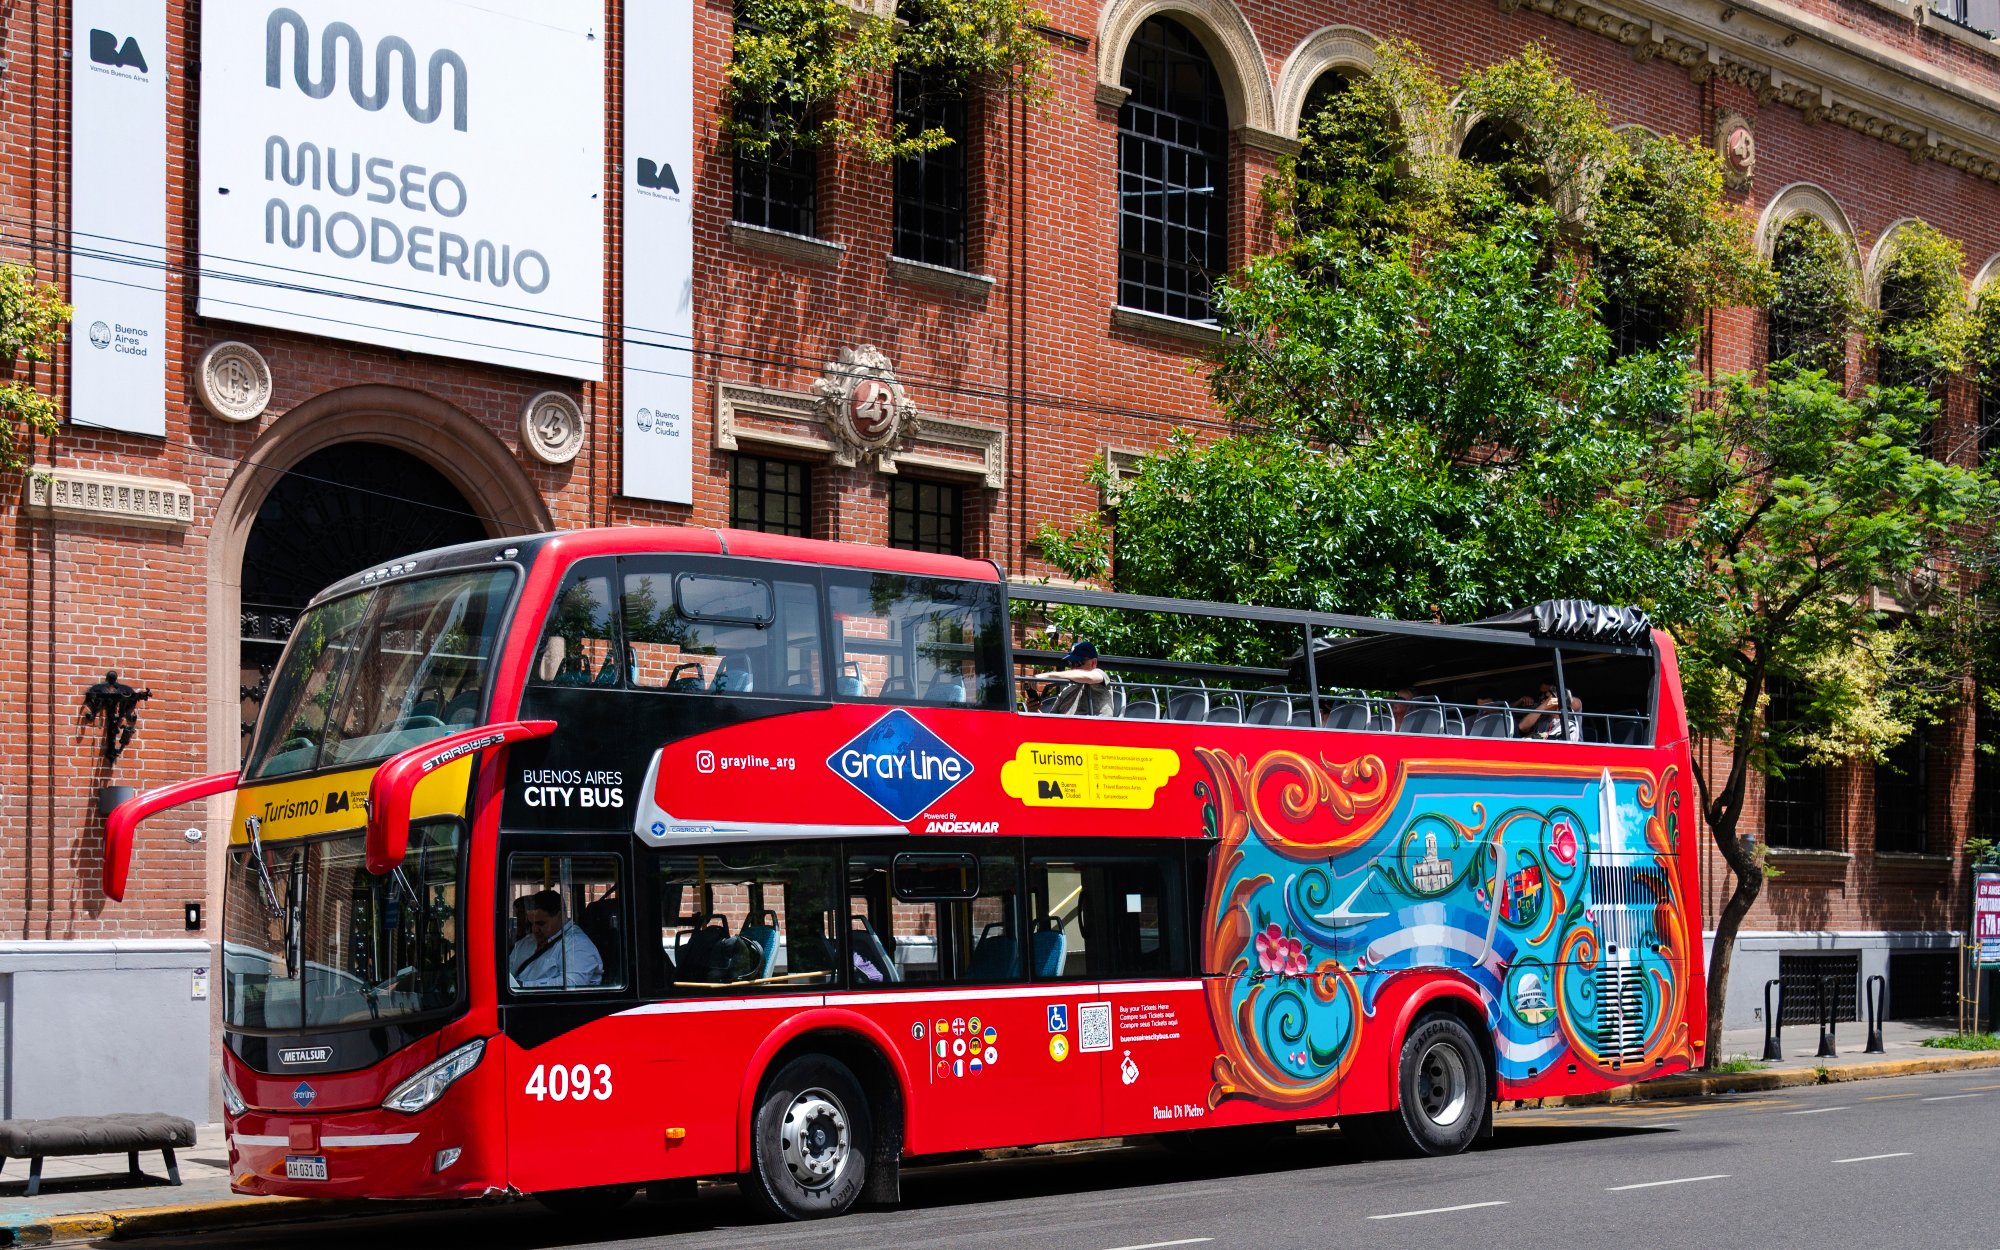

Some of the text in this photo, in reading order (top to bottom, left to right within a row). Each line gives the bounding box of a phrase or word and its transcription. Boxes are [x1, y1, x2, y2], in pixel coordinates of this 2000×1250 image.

[90, 28, 148, 73] BA
[90, 65, 149, 83] Vamos Buenos Aires
[265, 134, 467, 218] MUSEO
[637, 157, 680, 195] BA
[265, 197, 550, 294] MODERNO
[115, 323, 148, 337] Buenos
[115, 334, 140, 346] Aires
[115, 344, 147, 356] Ciudad
[655, 410, 680, 420] Buenos
[655, 418, 674, 428] Aires
[655, 427, 680, 437] Ciudad
[720, 755, 796, 770] grayline_arg
[841, 749, 962, 781] Gray Line
[1030, 750, 1083, 766] Turismo
[523, 769, 623, 785] BUENOS AIRES
[524, 786, 624, 808] CITY BUS
[1038, 780, 1063, 800] BA
[325, 790, 350, 814] BA
[263, 799, 319, 823] Turismo
[923, 812, 957, 821] Powered By
[925, 821, 1000, 833] ANDESMAR
[1120, 1005, 1128, 1013] Buy
[1120, 1013, 1138, 1021] Compre
[1120, 1033, 1180, 1042] buenosairescitybus.com
[284, 1050, 326, 1062] METALSUR
[525, 1063, 613, 1102] 4093
[1153, 1103, 1205, 1120] Paula Di Pietro
[288, 1163, 299, 1177] AH
[299, 1163, 315, 1177] 031
